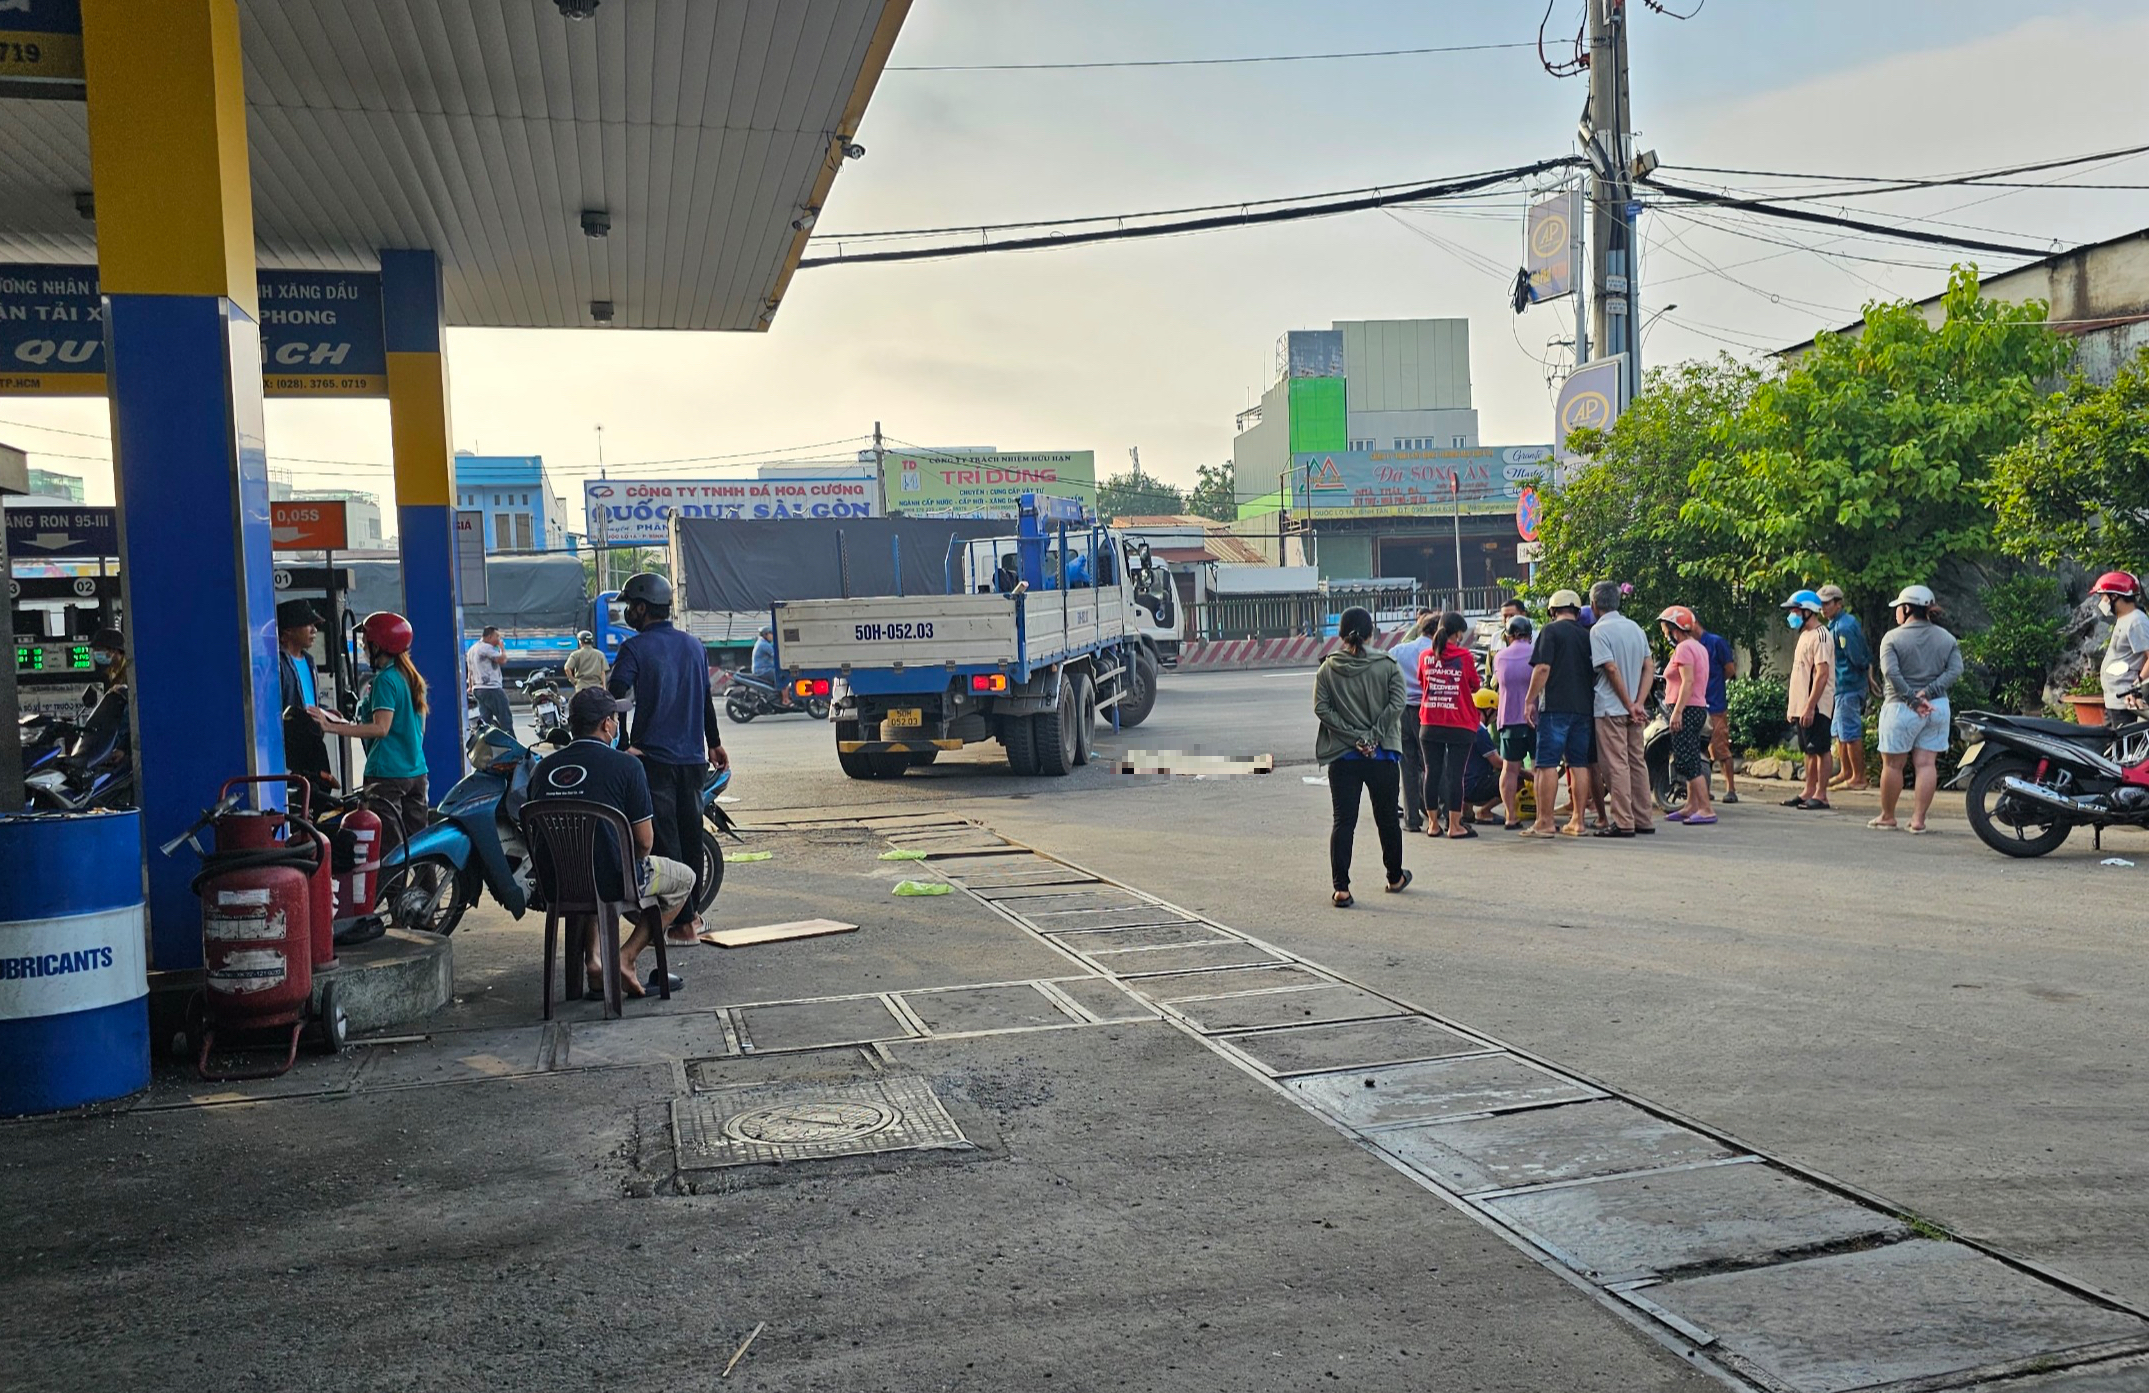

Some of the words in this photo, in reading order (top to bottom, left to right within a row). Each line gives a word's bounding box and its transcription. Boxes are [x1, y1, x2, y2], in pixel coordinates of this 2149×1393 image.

[43, 277, 90, 295] NHÂN
[278, 282, 321, 299] XĂNG
[326, 280, 358, 299] DẦU
[35, 301, 78, 321] TẢI
[14, 339, 106, 365] QU
[341, 380, 367, 389] 0719
[902, 460, 917, 470] TD
[1464, 460, 1492, 480] ÂN
[940, 465, 980, 485] TRÍ
[986, 465, 1057, 484] DŨNG
[626, 484, 673, 498] CÔNG
[676, 486, 698, 498] TY
[701, 486, 745, 497] TNHH
[749, 484, 770, 496] ĐÁ
[775, 486, 806, 496] HOA
[811, 483, 864, 495] CƯƠNG
[811, 498, 870, 518] GÒN
[41, 515, 69, 527] RON
[75, 515, 109, 527] 95-III
[277, 509, 320, 524] 0,05S
[76, 581, 93, 592] 02
[274, 574, 290, 585] 01
[855, 623, 934, 641] 50H-052.03
[1435, 660, 1443, 668] A
